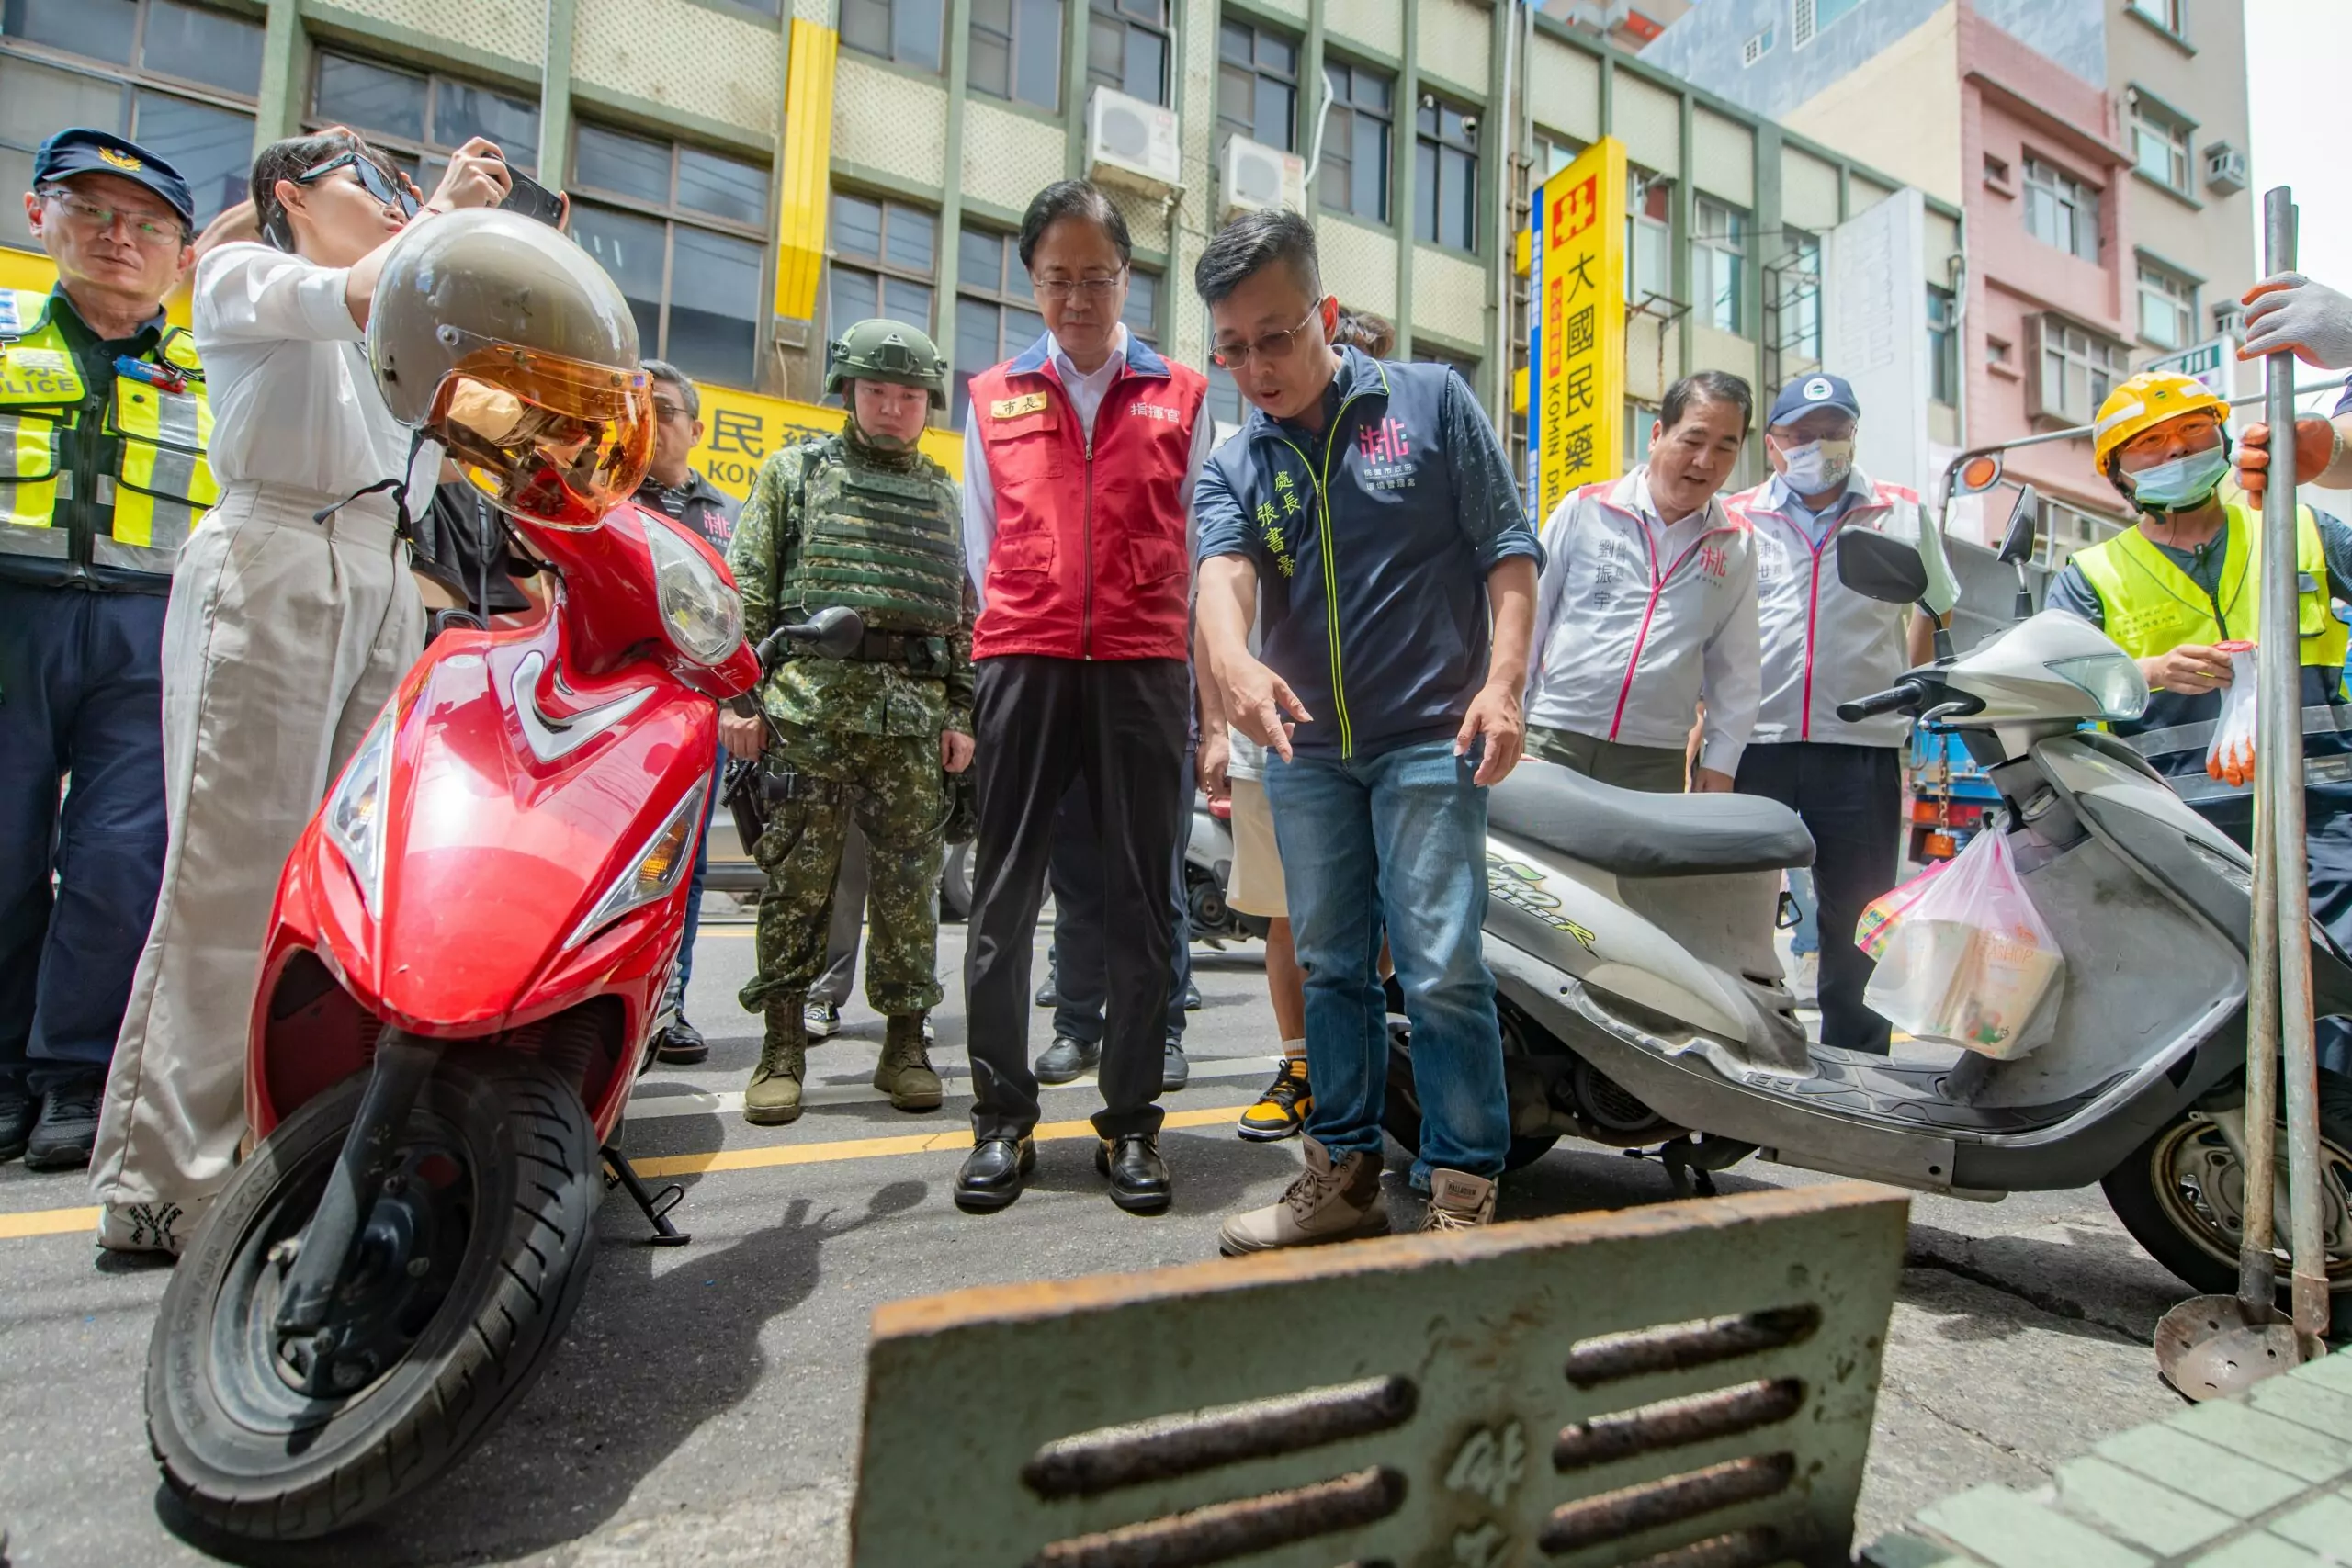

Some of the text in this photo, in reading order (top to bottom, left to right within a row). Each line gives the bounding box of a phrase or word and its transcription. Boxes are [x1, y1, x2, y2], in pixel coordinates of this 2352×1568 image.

[0, 353, 68, 377] 察
[0, 378, 77, 394] LICE
[1565, 252, 1594, 495] 大國民藥
[1002, 396, 1039, 416] 市長
[1130, 402, 1181, 424] 指揮官
[1547, 382, 1561, 457] KOMIN
[1274, 470, 1302, 516] 處長
[1256, 500, 1295, 579] 張書豪
[1593, 538, 1615, 611] 劉振宇
